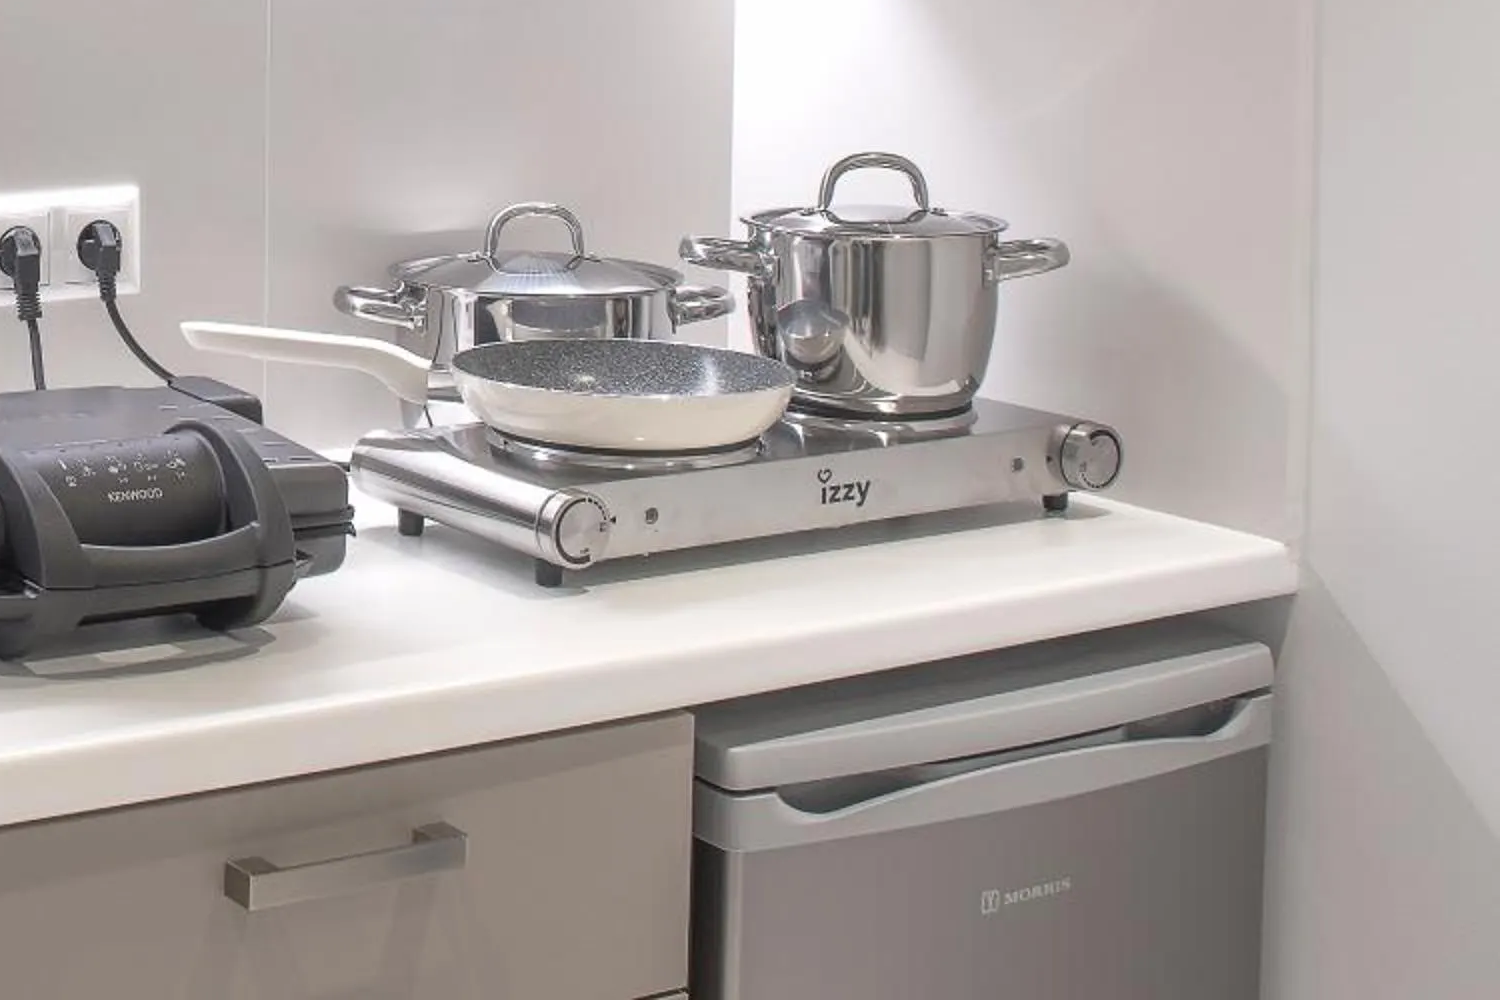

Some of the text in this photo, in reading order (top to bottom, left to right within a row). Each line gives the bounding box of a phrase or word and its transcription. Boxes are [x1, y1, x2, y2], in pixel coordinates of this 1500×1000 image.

[108, 487, 164, 503] KENWOOD
[817, 468, 871, 507] izzy
[1004, 877, 1071, 905] MORRIS
